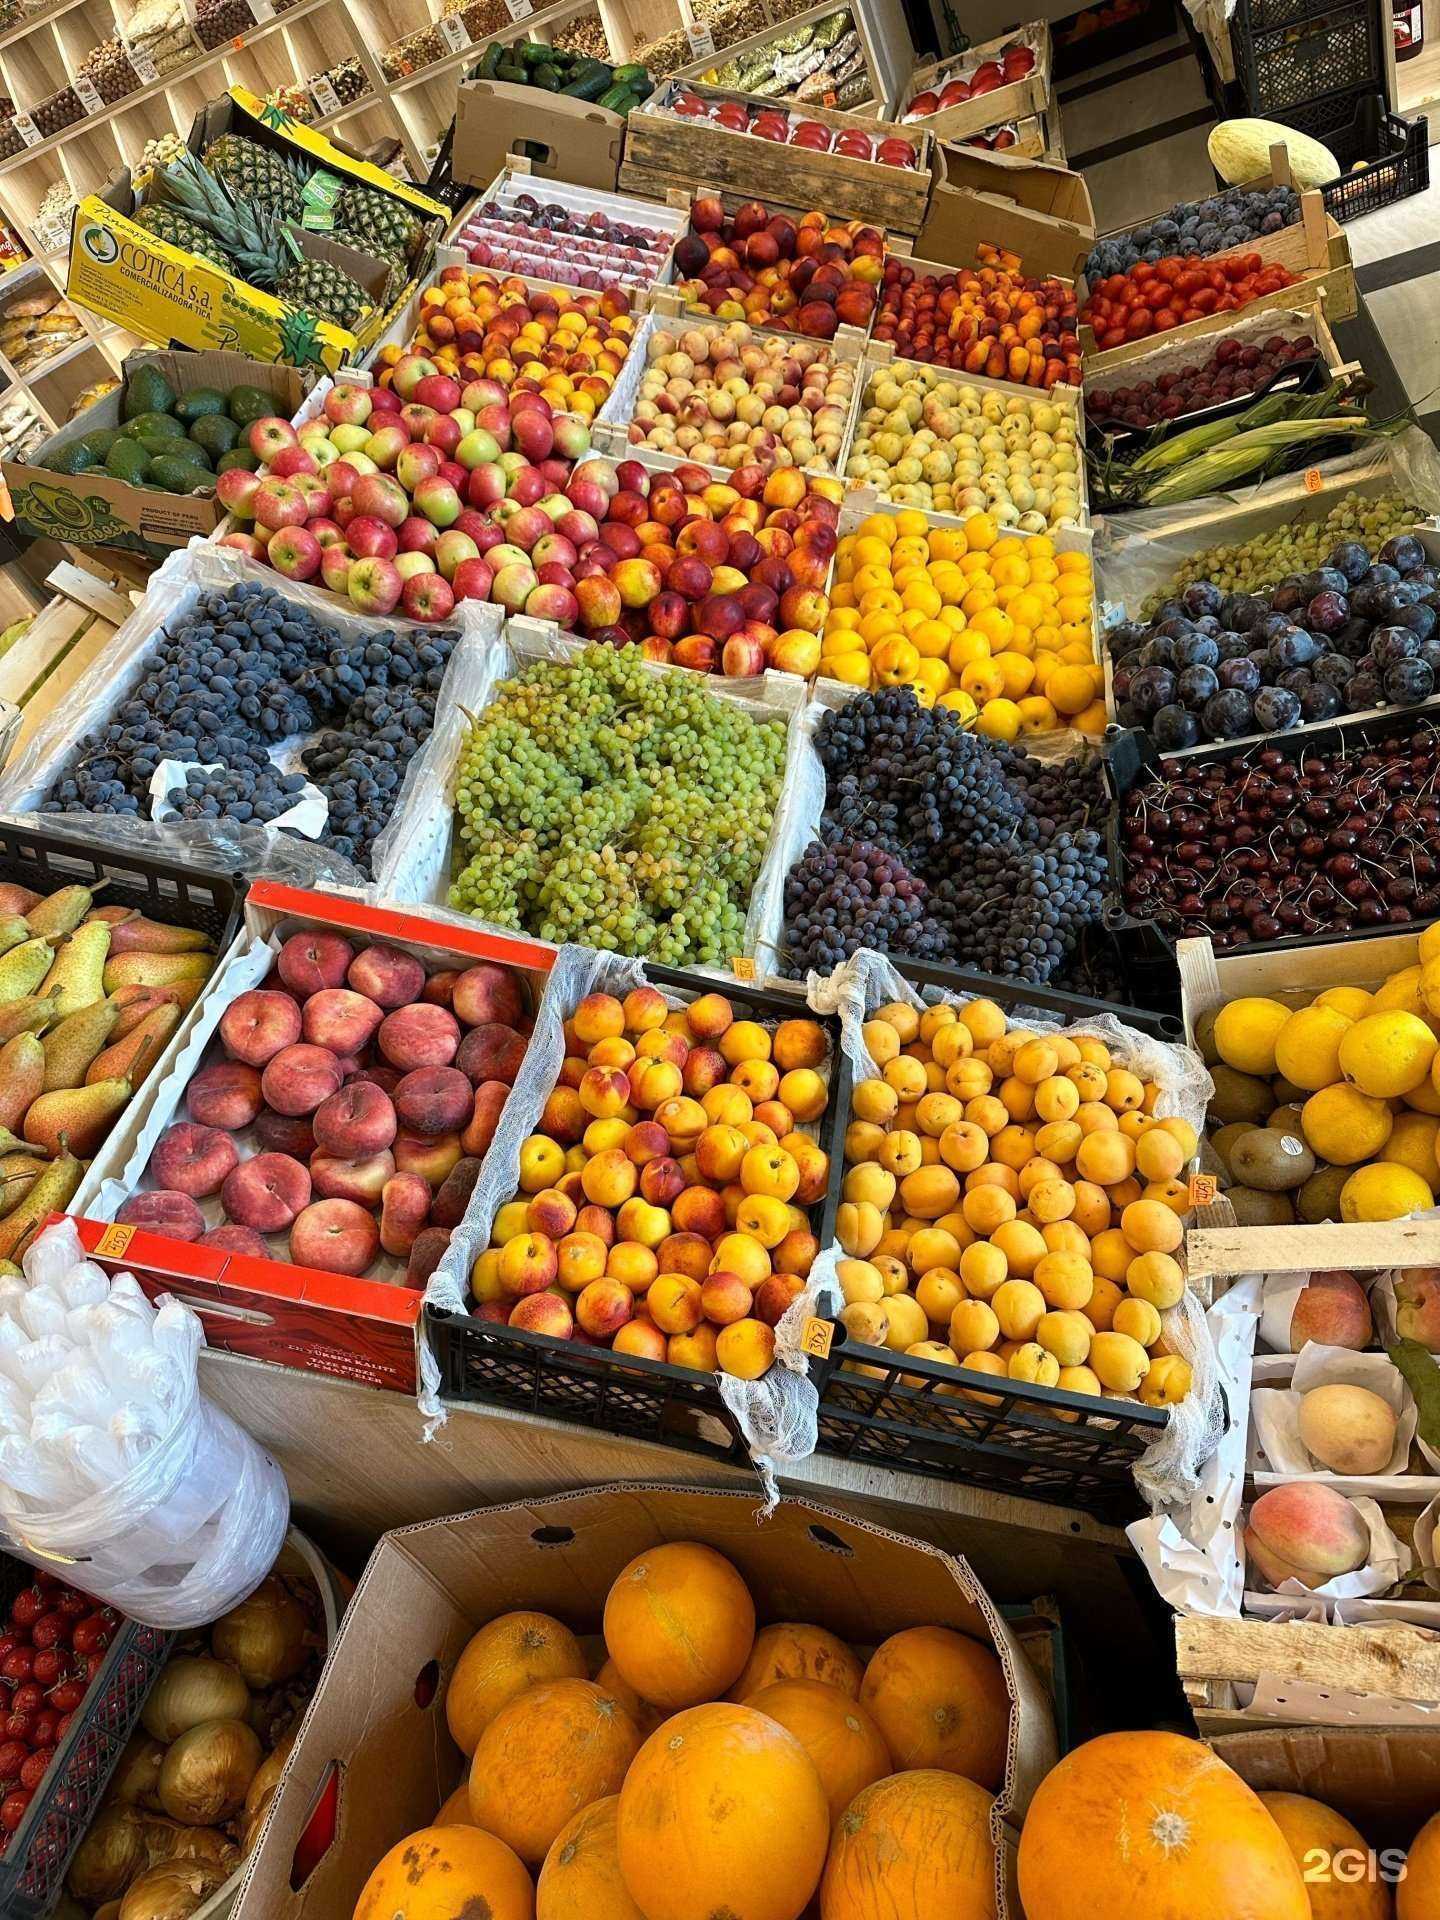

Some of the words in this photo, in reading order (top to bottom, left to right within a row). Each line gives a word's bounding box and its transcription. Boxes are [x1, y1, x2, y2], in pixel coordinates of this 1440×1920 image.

[120, 242, 185, 296] COTICA
[188, 284, 213, 311] s.a.
[120, 266, 193, 312] COMERCIALIZADORA
[195, 305, 211, 321] TICA
[142, 507, 170, 515] PRODUCT
[50, 521, 121, 541] AVOCADOS
